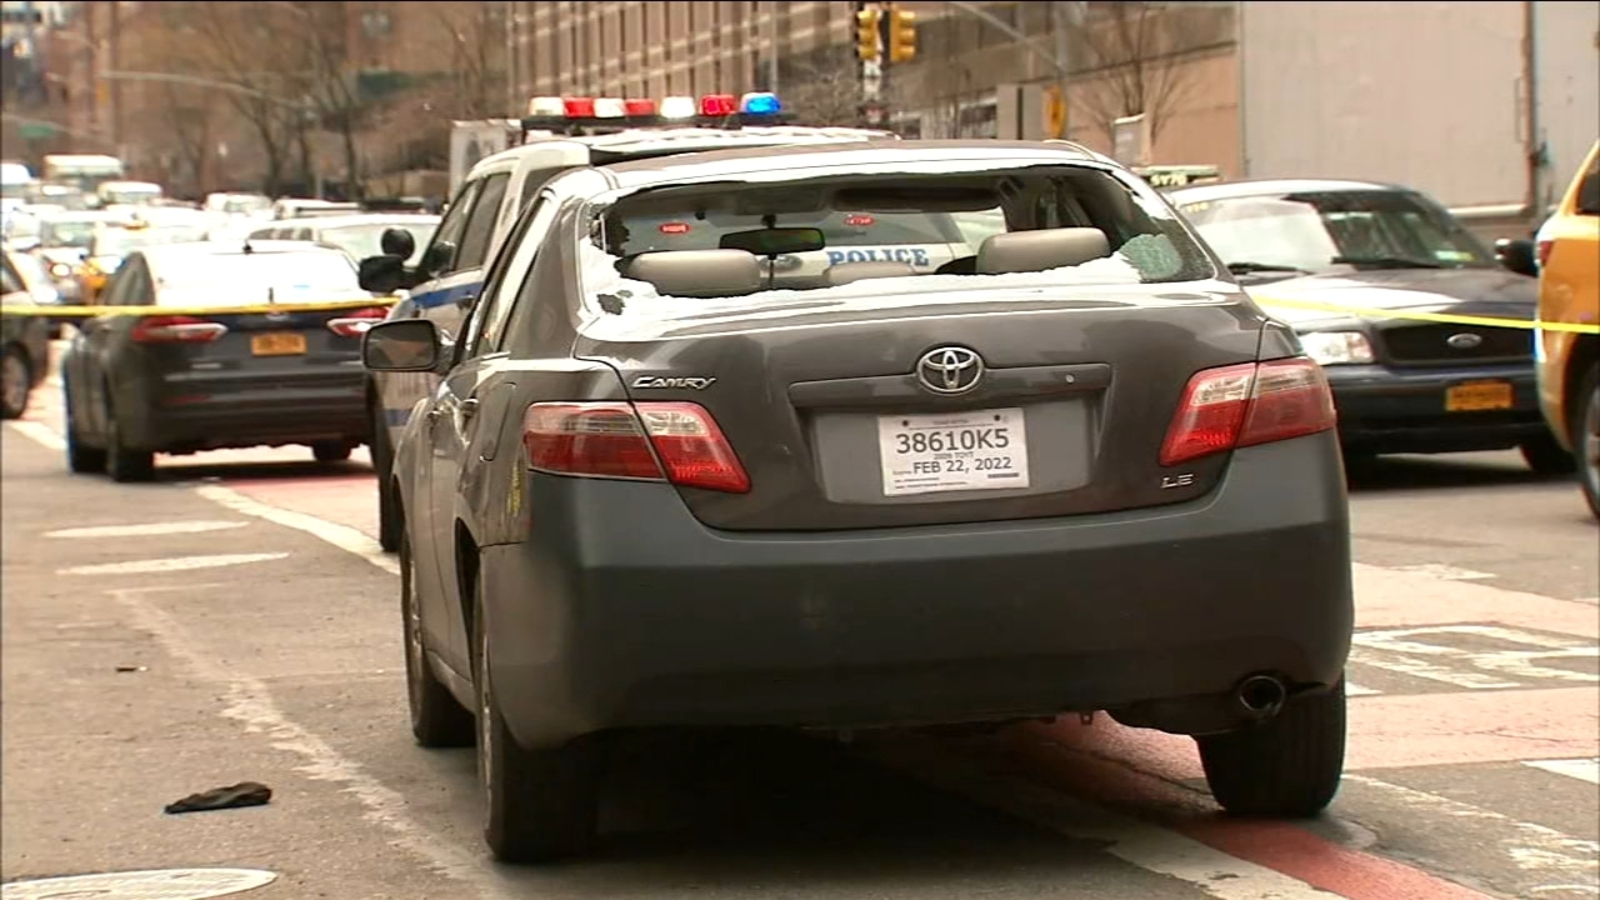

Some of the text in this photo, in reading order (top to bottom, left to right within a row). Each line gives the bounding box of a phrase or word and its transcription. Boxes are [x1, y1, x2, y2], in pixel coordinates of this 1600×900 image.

[826, 248, 929, 266] POLICE
[631, 376, 717, 390] CAMRY
[896, 427, 1009, 454] 38610K5
[913, 456, 1012, 475] FEB 22, 2022
[1160, 474, 1194, 488] LE
